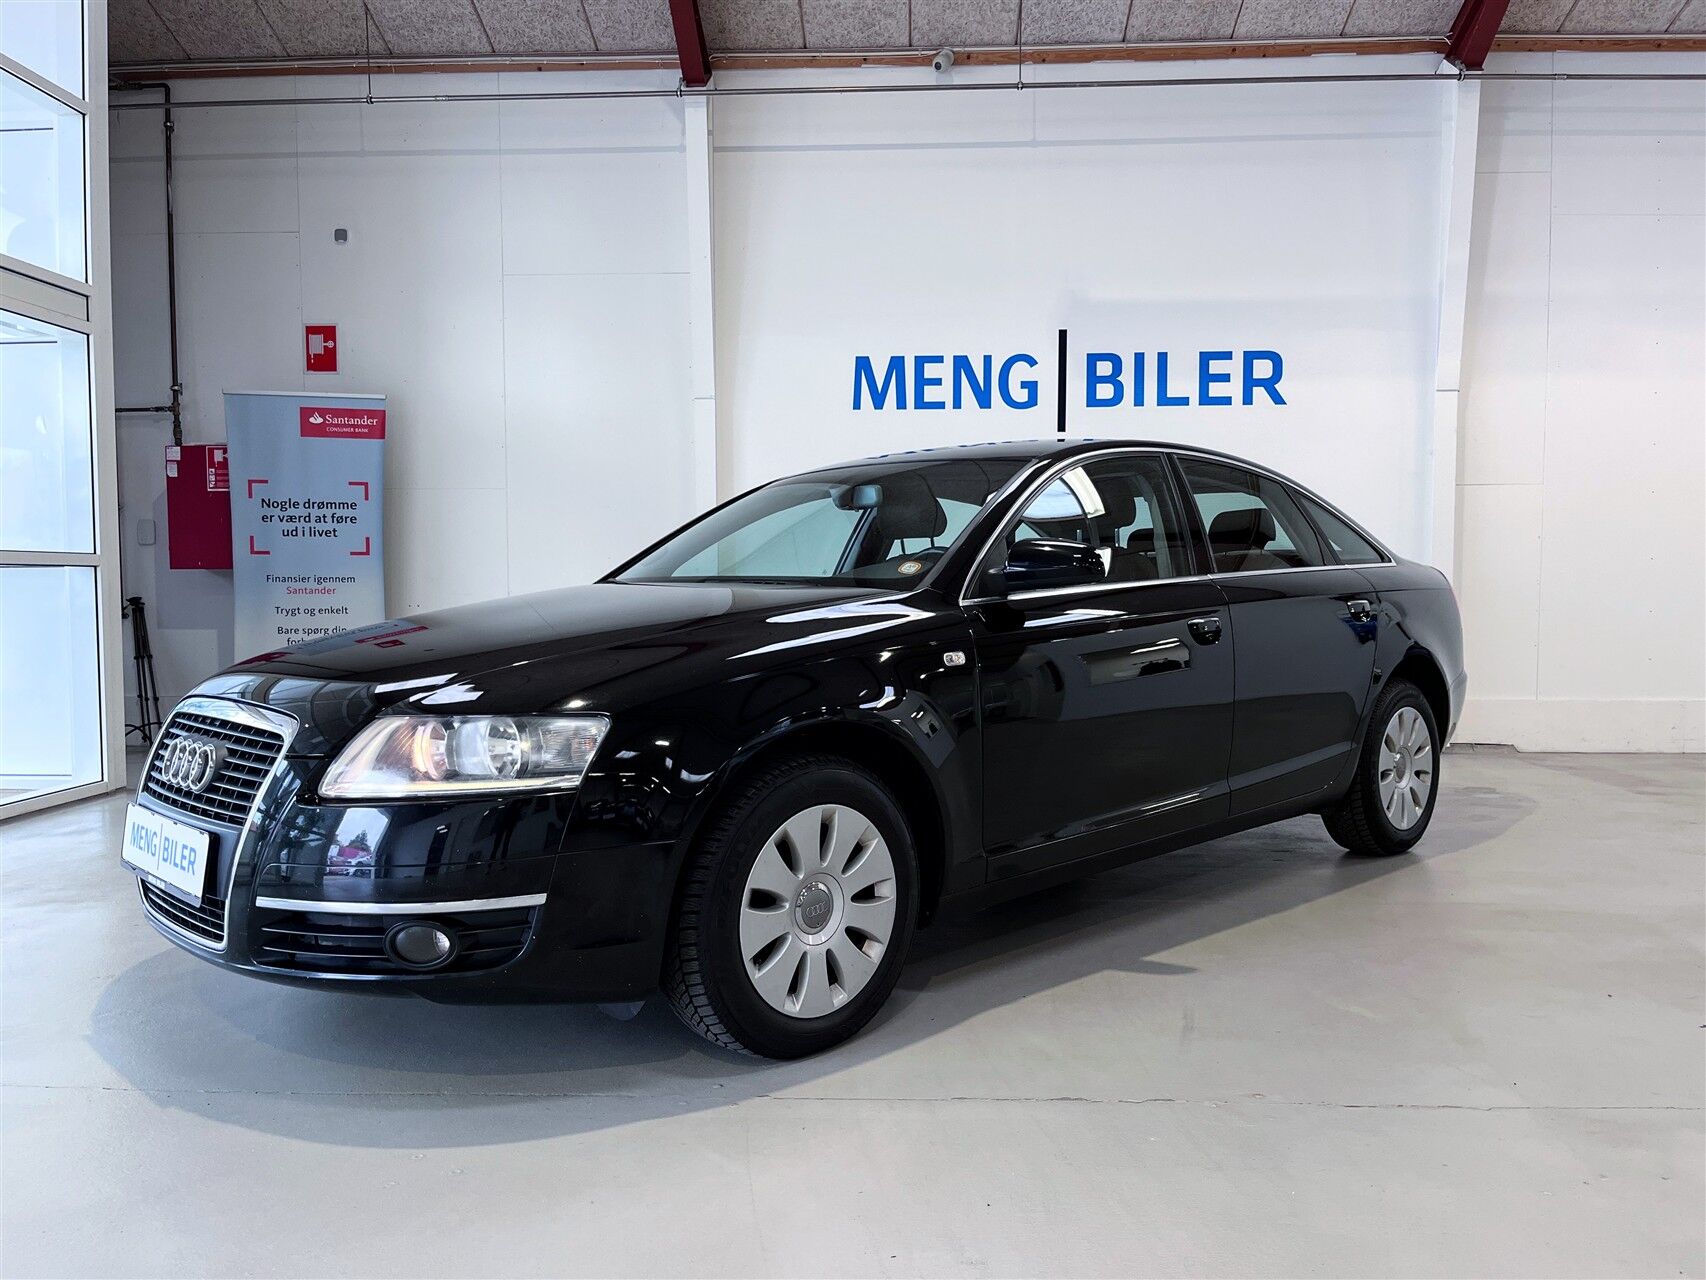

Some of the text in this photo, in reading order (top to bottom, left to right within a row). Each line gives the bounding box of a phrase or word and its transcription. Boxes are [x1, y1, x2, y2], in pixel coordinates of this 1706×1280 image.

[852, 349, 1288, 411] MENG BILER
[325, 414, 378, 426] Santander
[261, 498, 358, 512] Nogle drømme
[261, 513, 358, 524] er værd at føre
[282, 526, 338, 537] ud i livet
[266, 575, 356, 585] Finansier igennem
[286, 586, 337, 595] Santander
[275, 606, 349, 616] Trygt og enkelt
[277, 627, 300, 635] Bare
[302, 628, 329, 636] spørg
[130, 821, 197, 876] MENG BILER
